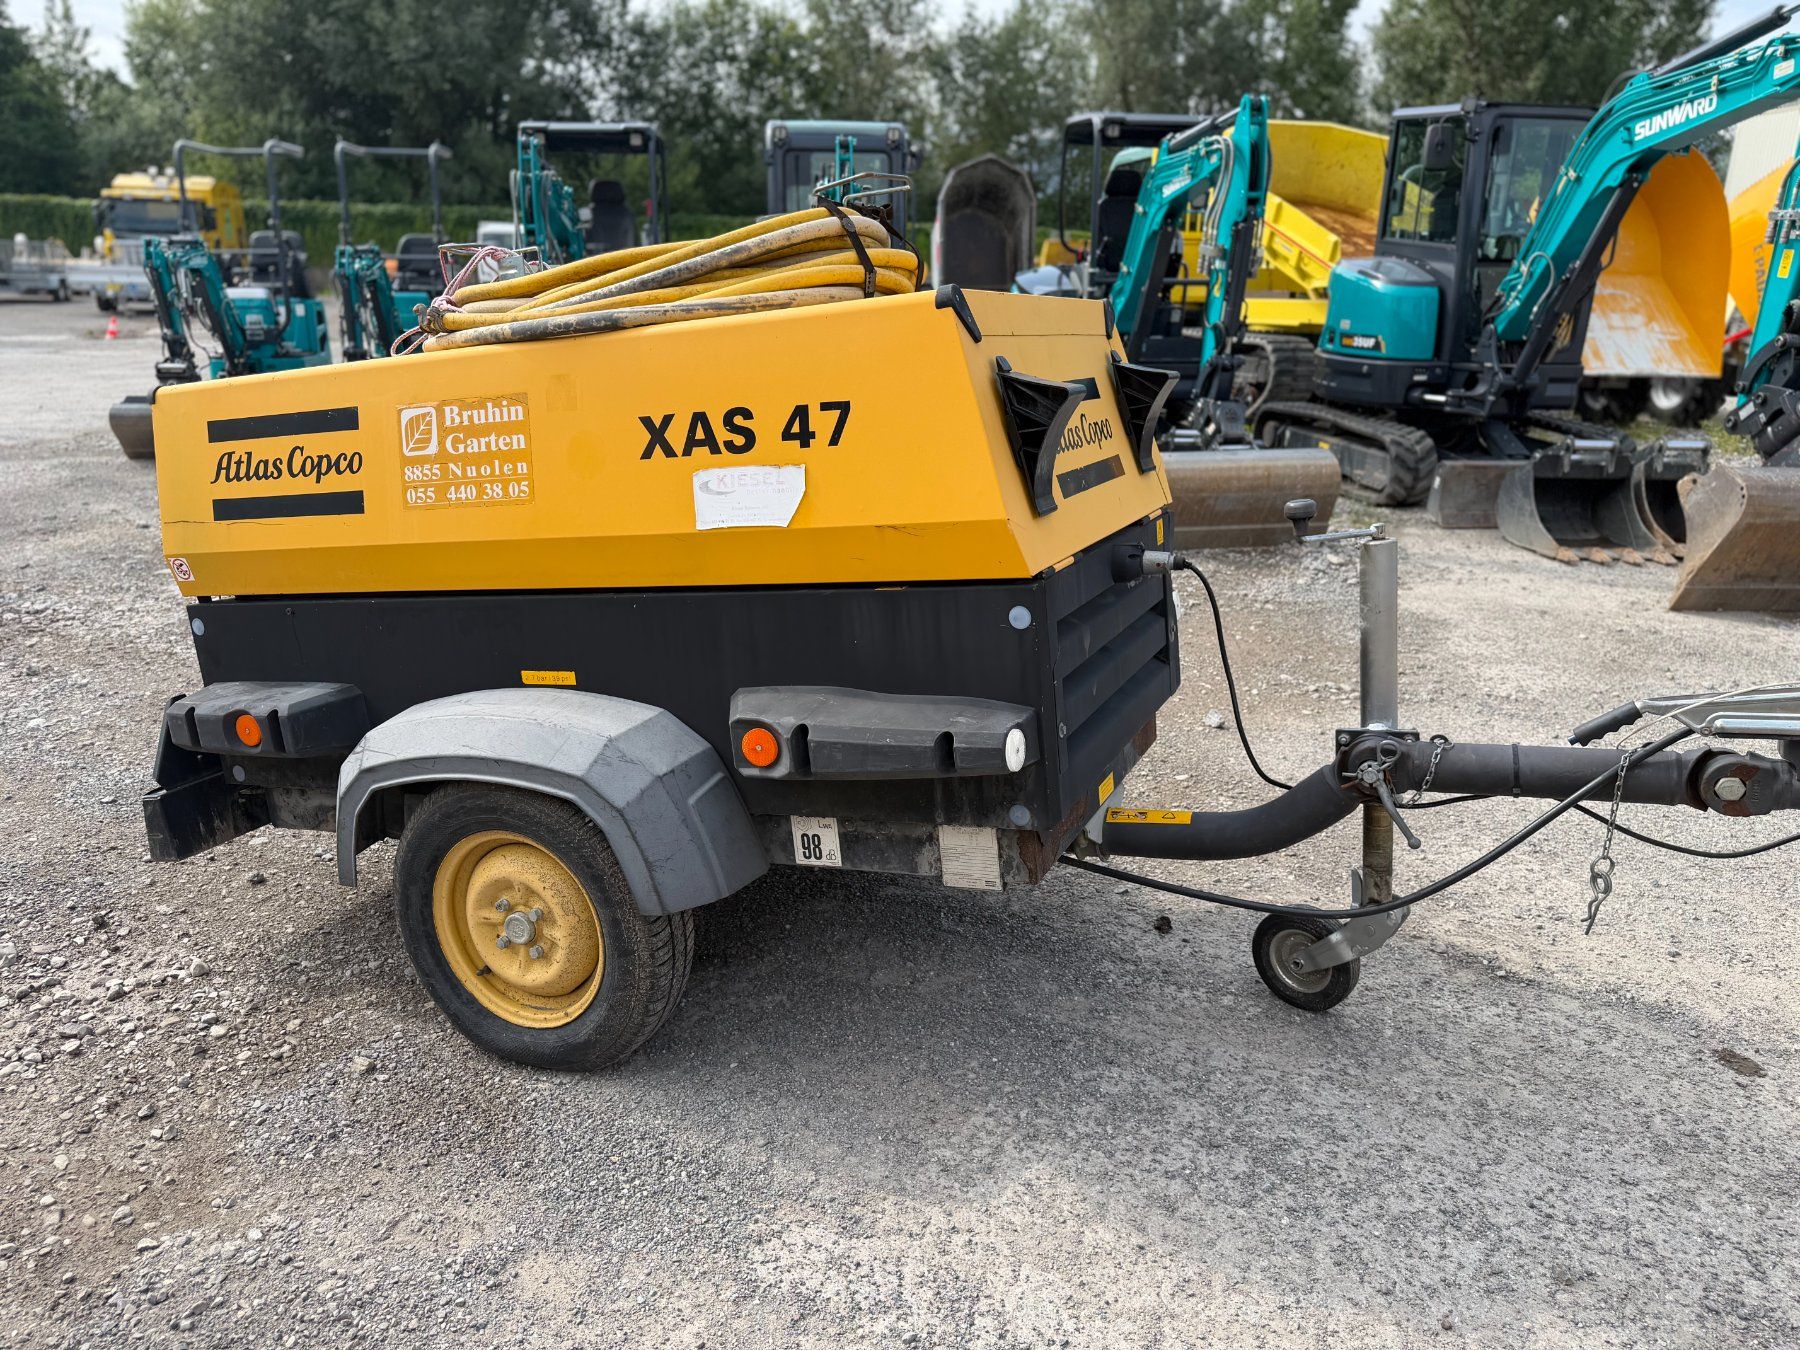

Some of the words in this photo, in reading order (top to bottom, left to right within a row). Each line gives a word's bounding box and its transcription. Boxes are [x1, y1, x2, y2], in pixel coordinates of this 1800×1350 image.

[1634, 93, 1718, 142] SUNWARD
[443, 400, 525, 428] Bruhin
[445, 432, 527, 455] Garten
[638, 406, 757, 461] XAS
[781, 400, 852, 449] 47
[1080, 413, 1113, 450] Copco
[210, 450, 283, 485] Atlas
[287, 445, 363, 484] Copco
[404, 464, 441, 482] 8855
[448, 459, 528, 479] Nuolen
[406, 487, 436, 504] 055
[446, 484, 477, 501] 440
[482, 482, 503, 499] 38
[508, 481, 530, 498] 05
[800, 832, 823, 861] 98
